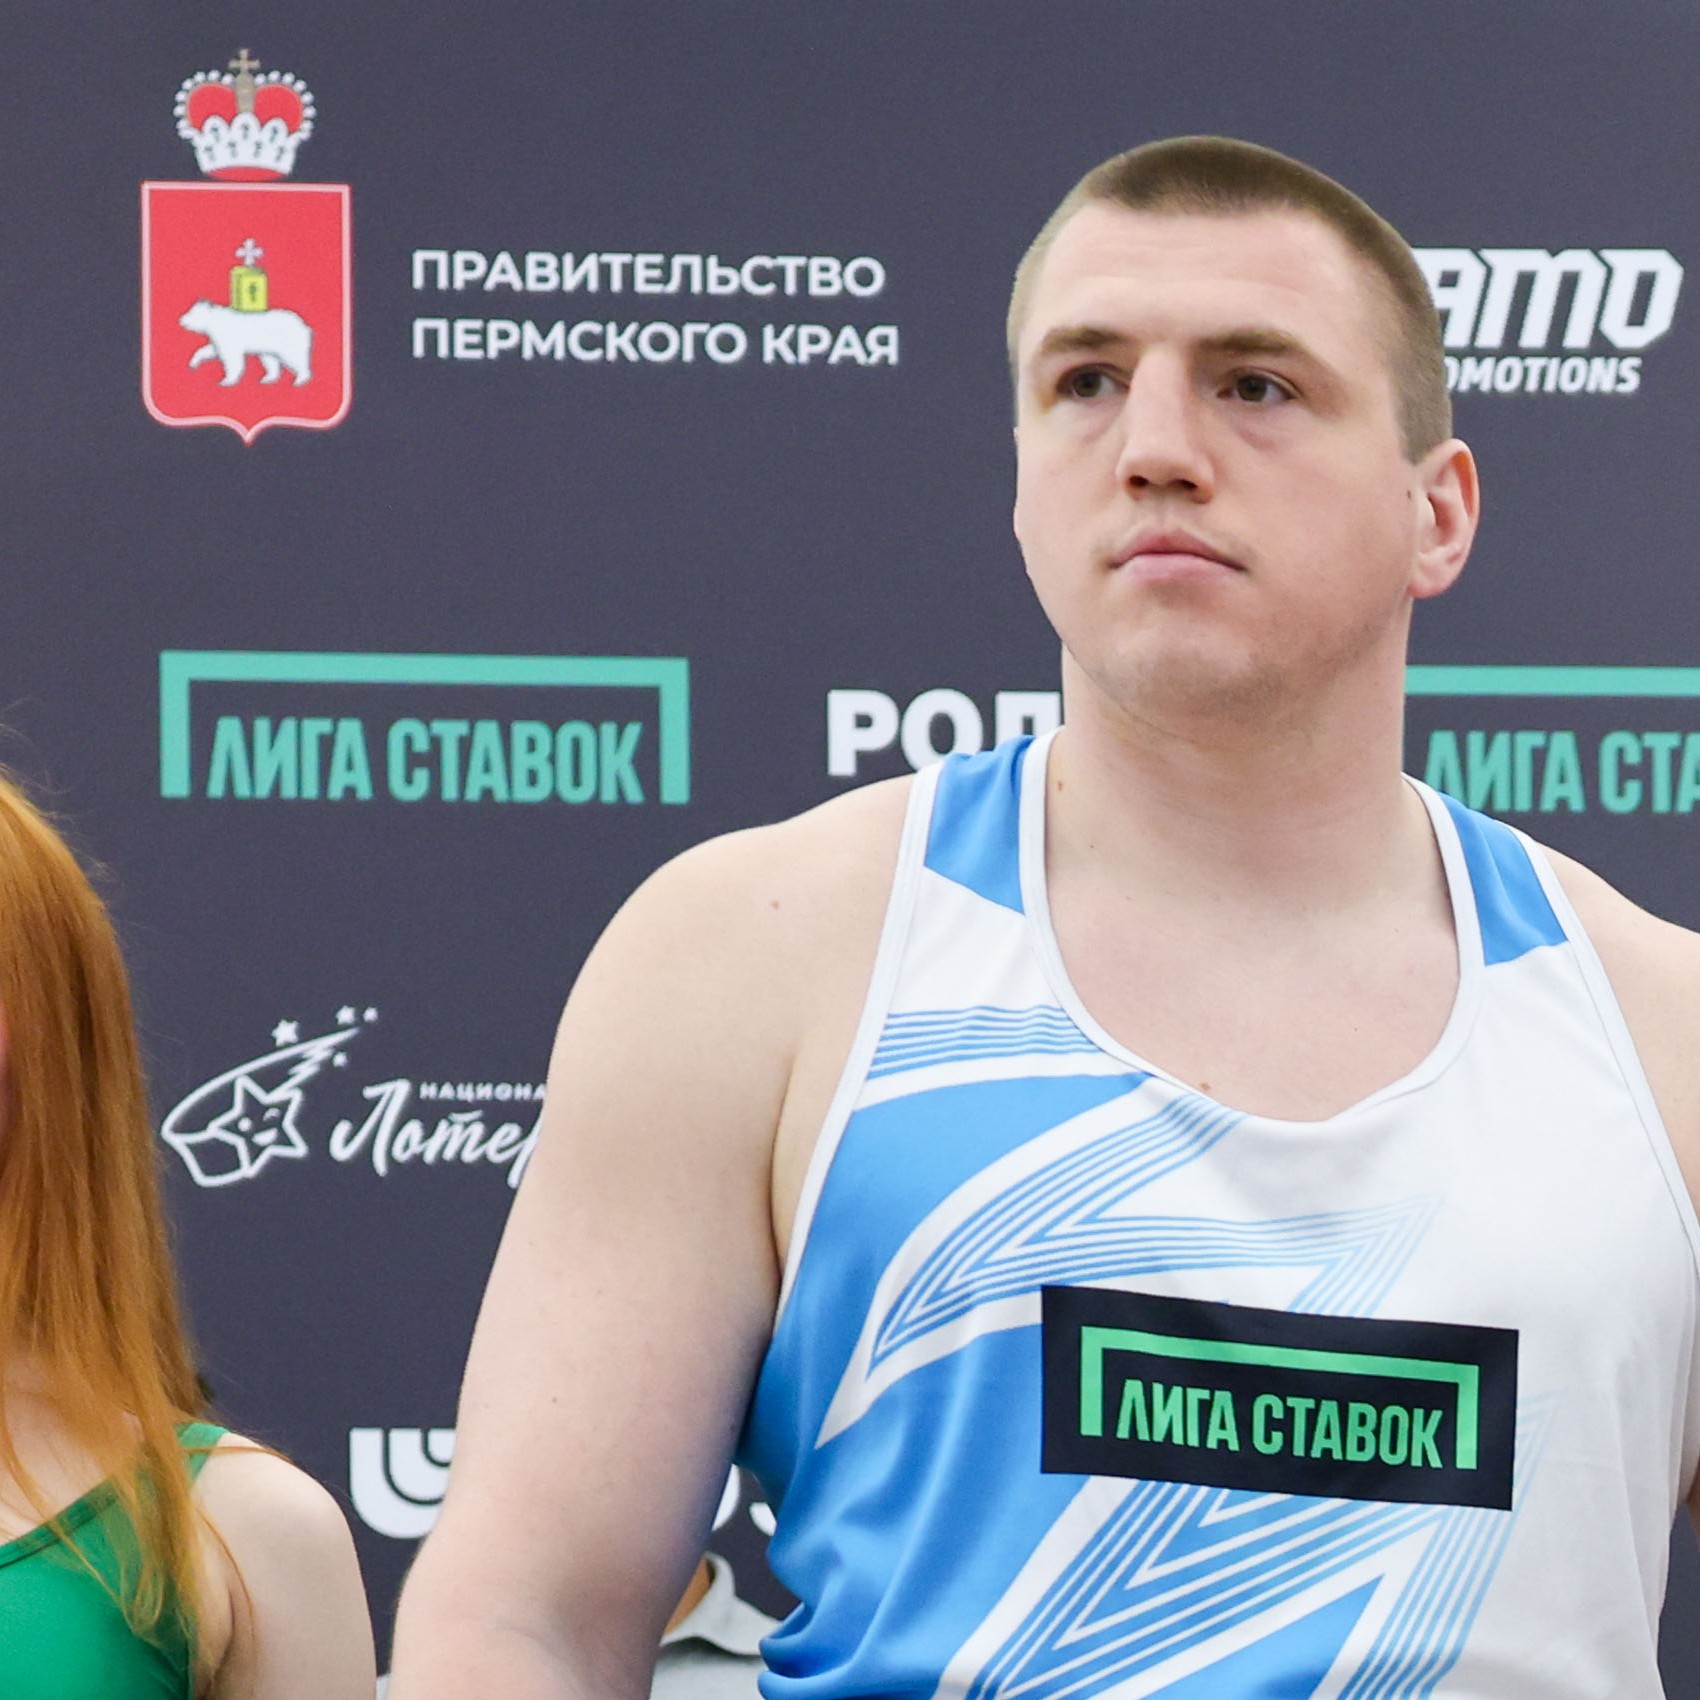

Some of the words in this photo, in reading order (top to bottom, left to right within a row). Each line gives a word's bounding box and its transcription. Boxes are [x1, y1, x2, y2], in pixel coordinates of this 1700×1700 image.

[411, 249, 886, 298] ПРАВИТЕЛЬСТВО
[1411, 248, 1684, 349] AMO
[411, 317, 748, 365] ПЕРМСКОГО
[762, 323, 899, 367] КРАЯ
[1445, 356, 1643, 393] MOTIONS
[207, 716, 372, 799] ЛИГА
[387, 717, 644, 806] СТАВОК
[1423, 729, 1585, 813] ЛИГА
[420, 1081, 547, 1103] НАЦИОНА
[1116, 1378, 1240, 1452] ЛИГА
[1251, 1394, 1443, 1469] СТАВОК
